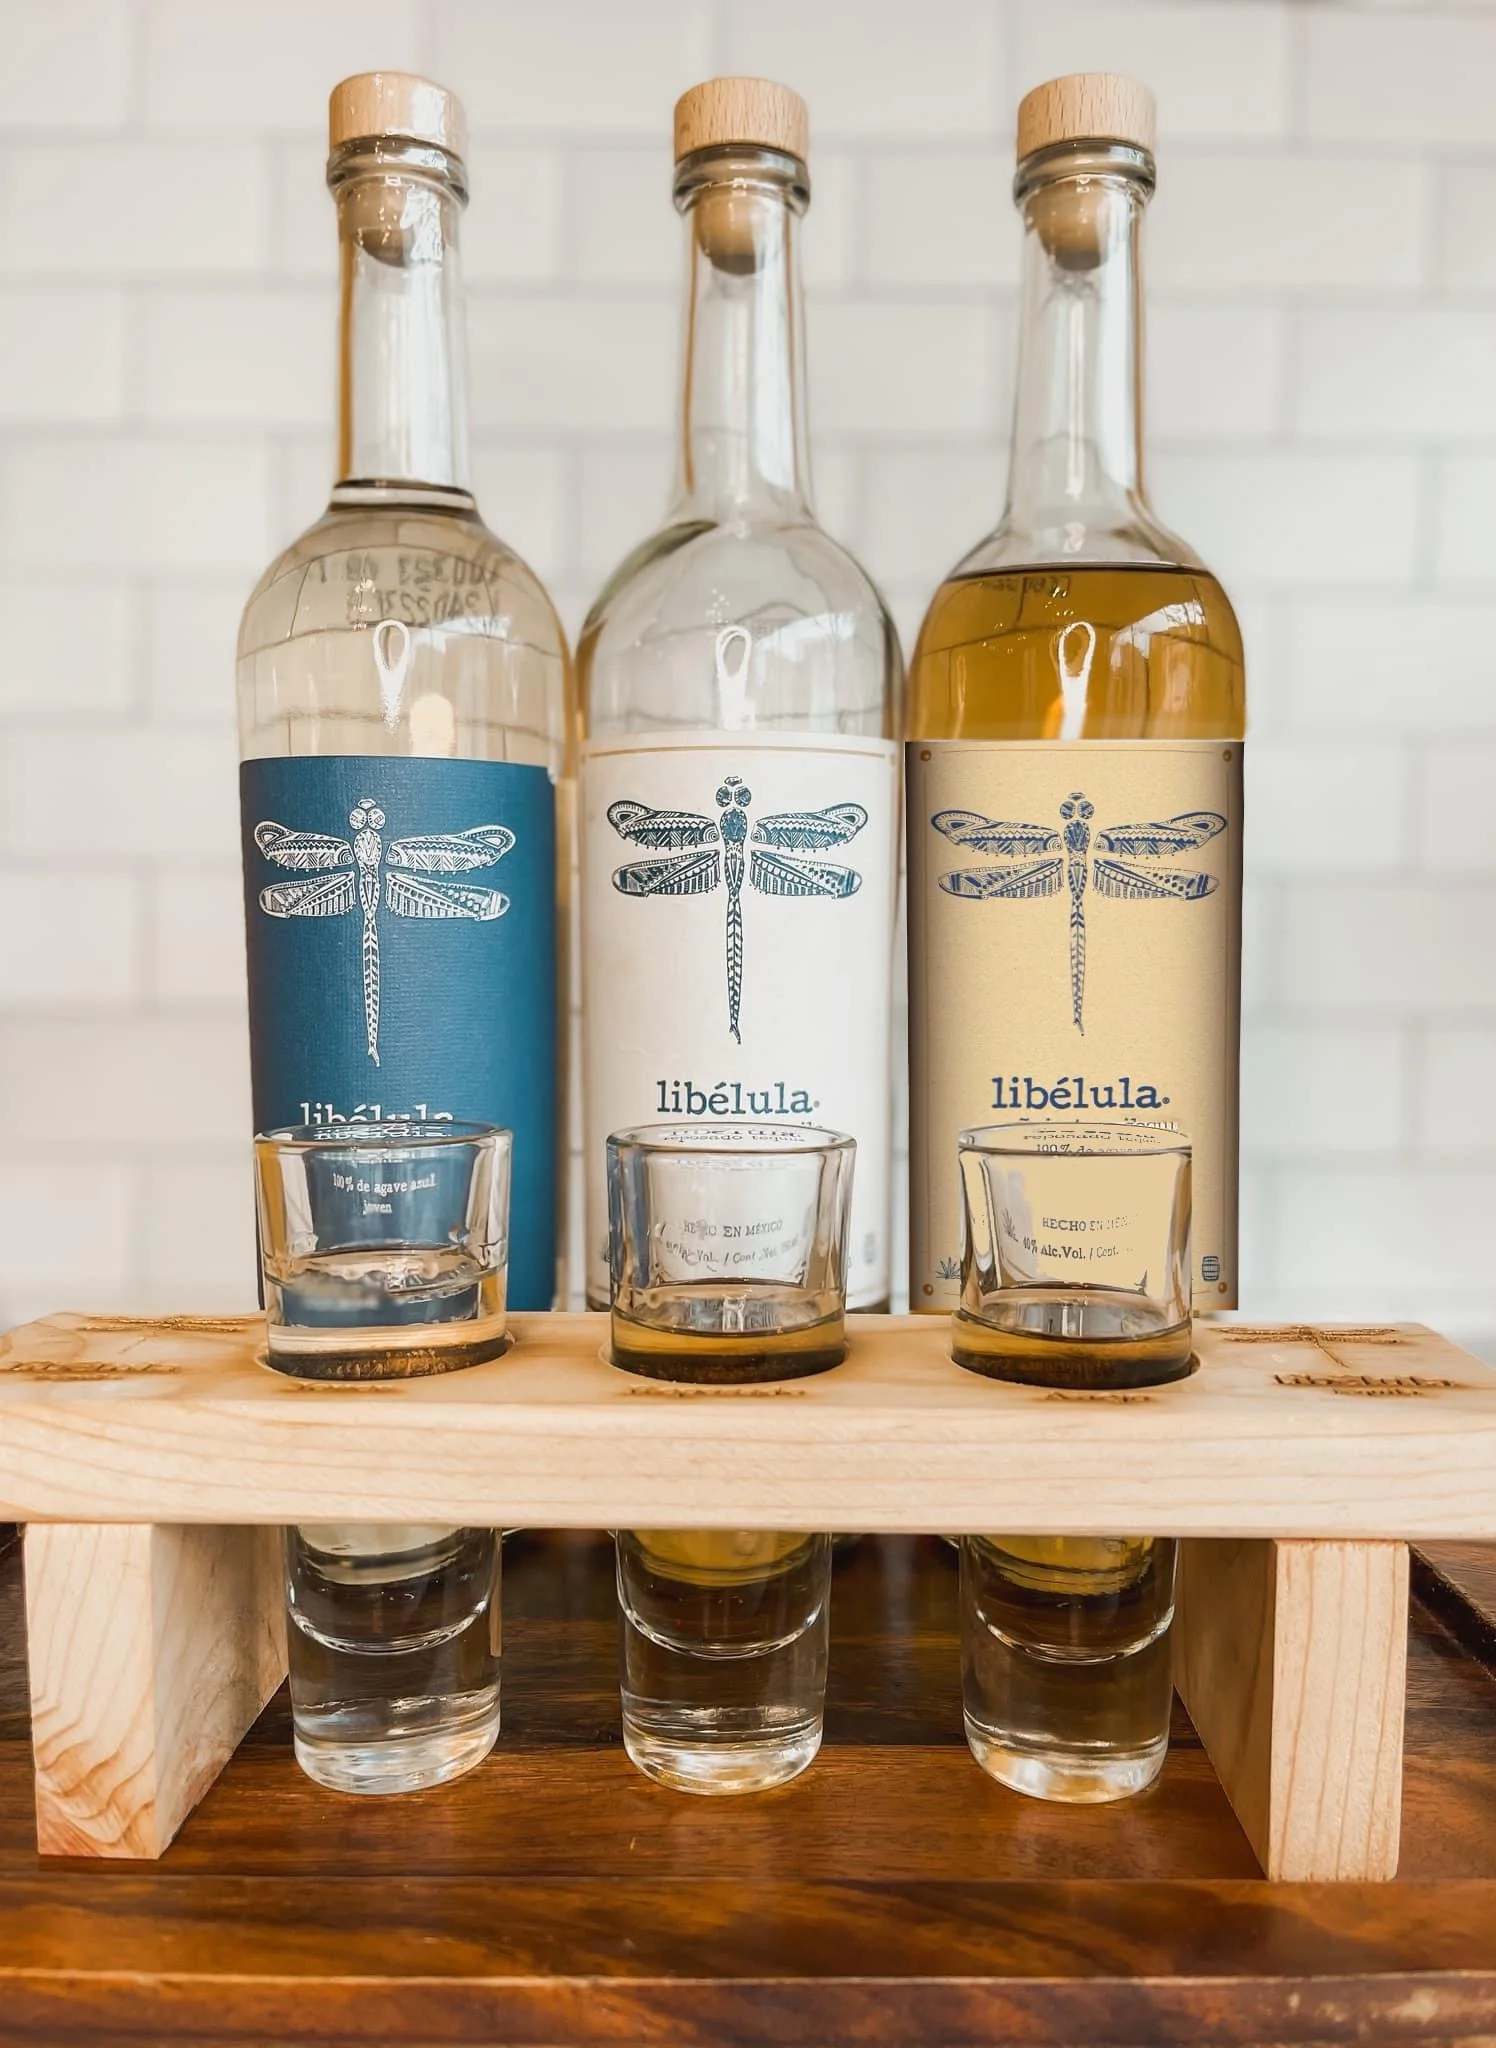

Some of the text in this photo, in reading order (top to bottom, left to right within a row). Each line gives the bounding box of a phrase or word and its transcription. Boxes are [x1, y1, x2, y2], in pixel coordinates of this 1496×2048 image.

[356, 1178, 371, 1192] de
[374, 1182, 408, 1197] agave
[683, 1219, 717, 1237] HEO
[723, 1225, 742, 1238] EN
[1042, 1216, 1087, 1232] HECHO
